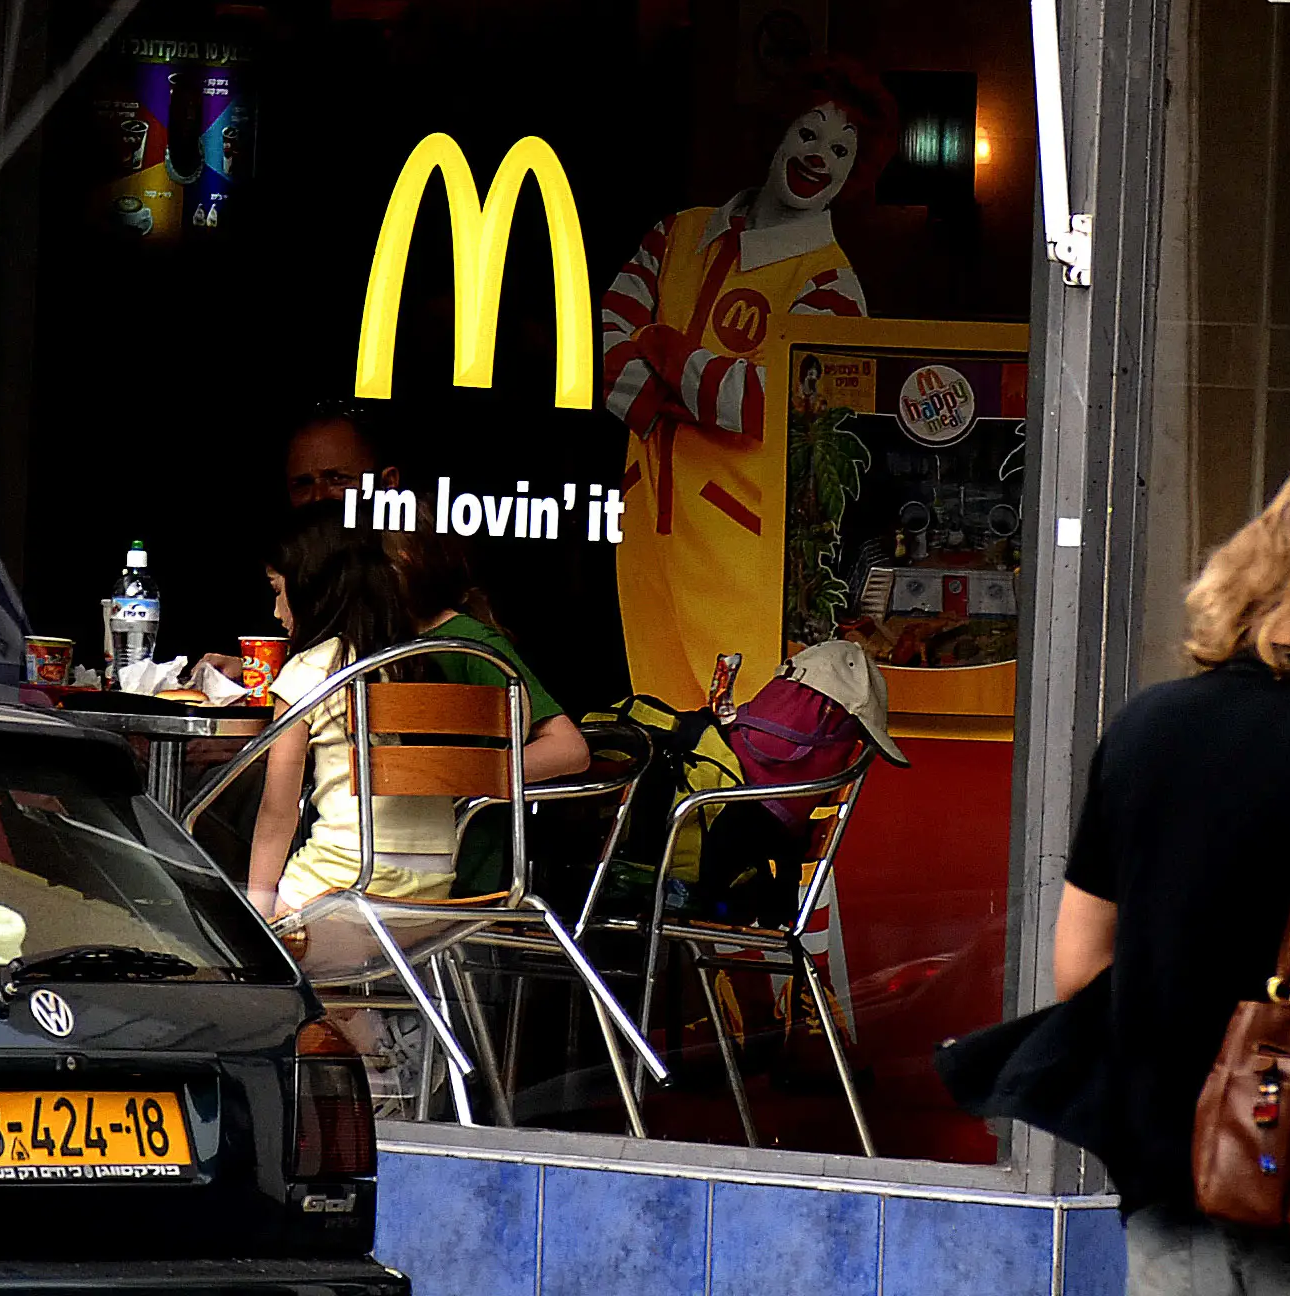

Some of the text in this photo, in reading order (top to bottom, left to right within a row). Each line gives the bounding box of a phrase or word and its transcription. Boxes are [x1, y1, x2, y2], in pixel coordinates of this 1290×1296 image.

[902, 380, 968, 422] happy
[342, 473, 626, 544] i'm lovin' it
